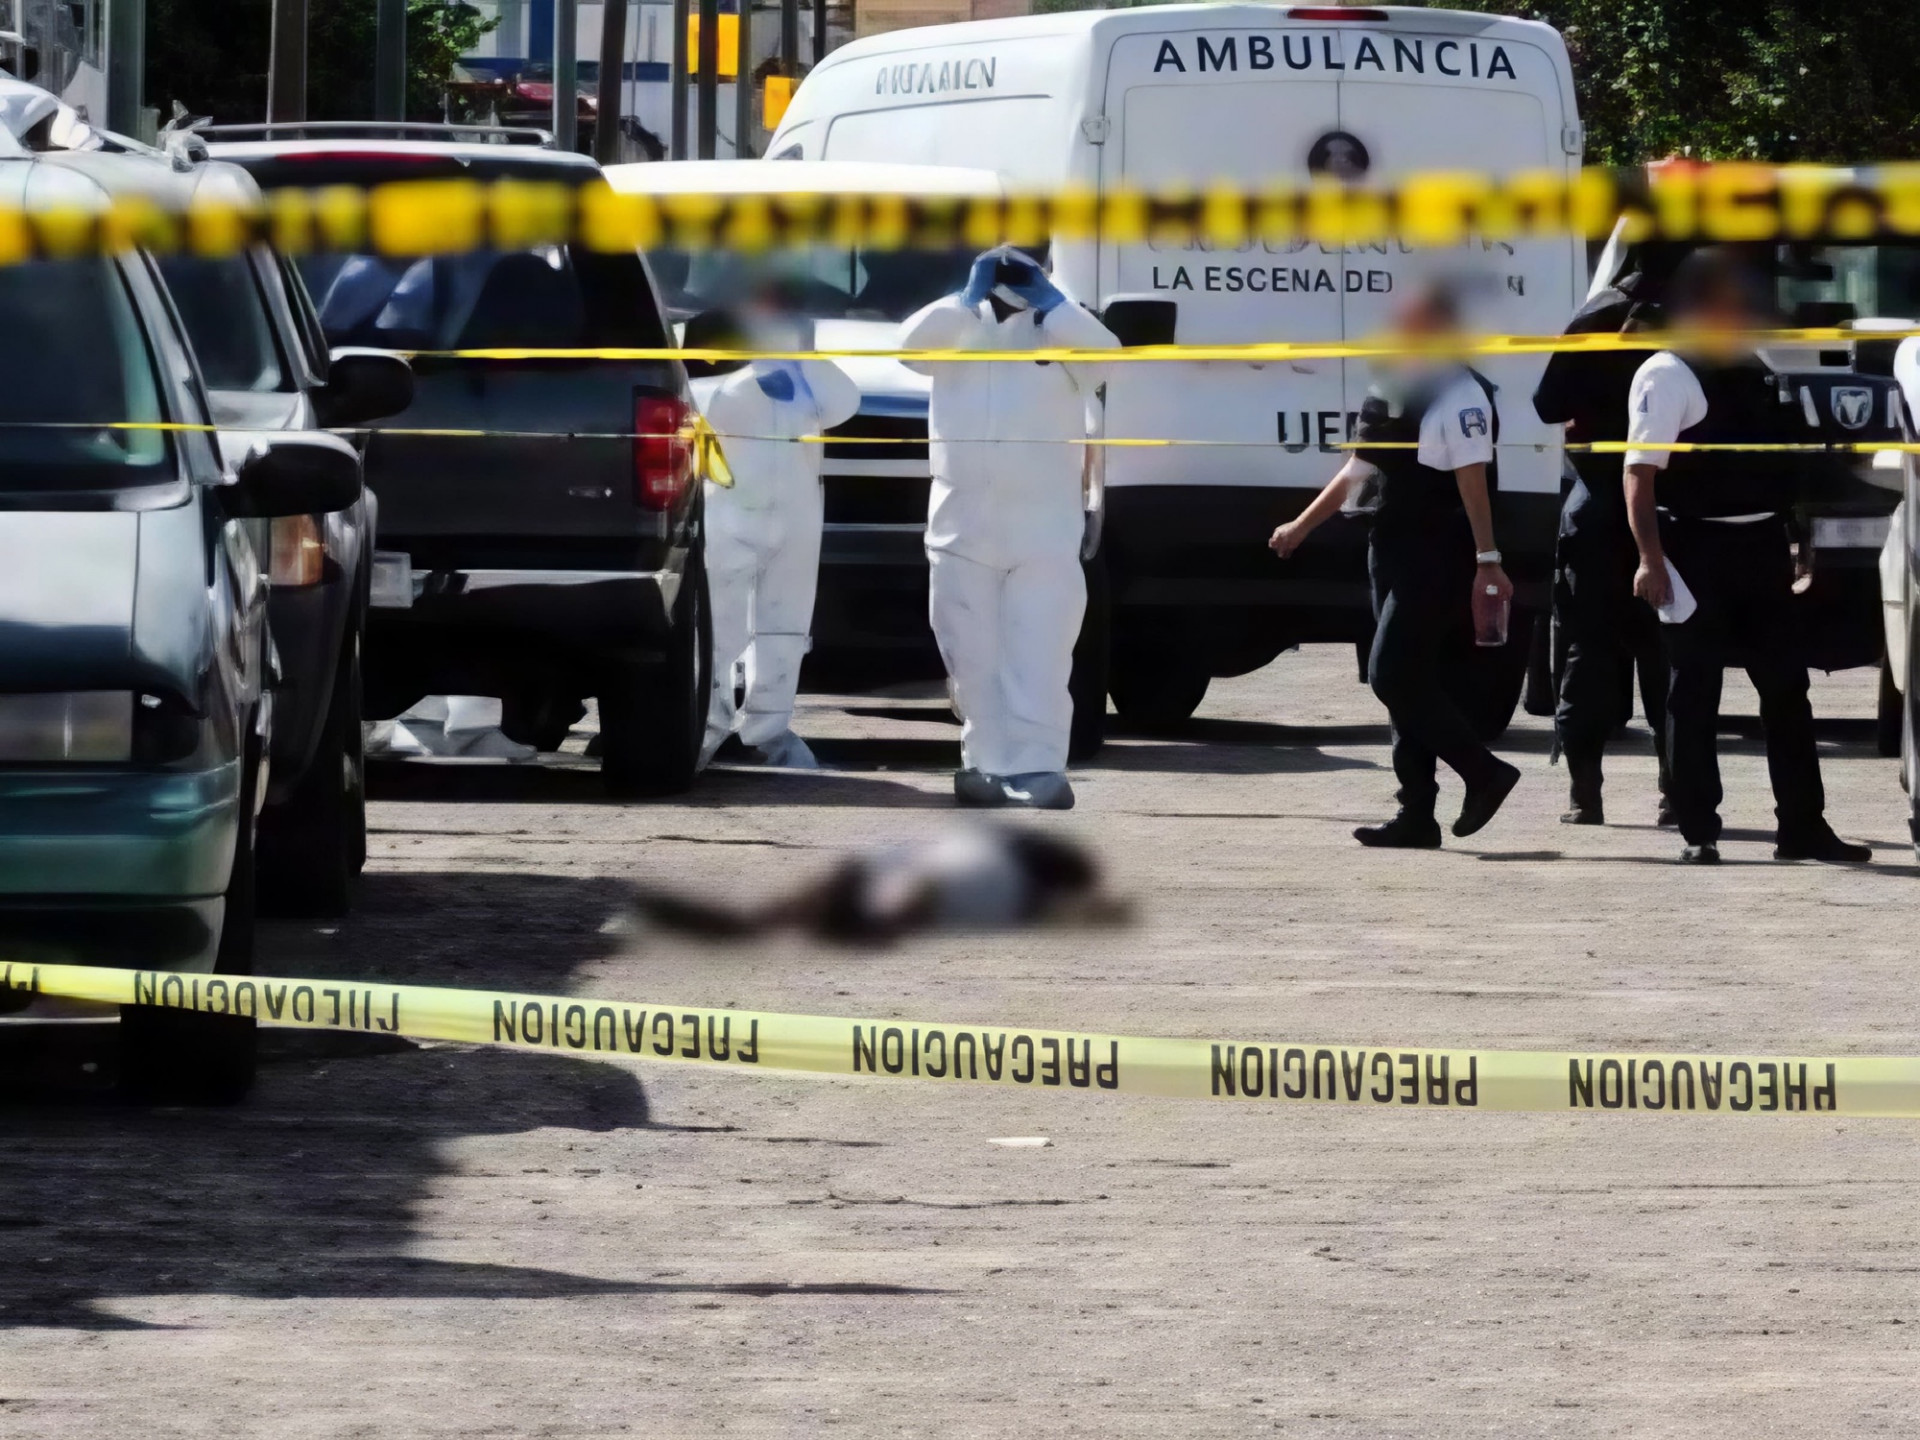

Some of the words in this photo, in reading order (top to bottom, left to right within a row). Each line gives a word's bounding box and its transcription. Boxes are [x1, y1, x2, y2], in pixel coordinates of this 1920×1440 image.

[1153, 35, 1516, 80] AMBULANCIA
[1153, 266, 1194, 290] LA
[1205, 267, 1336, 292] ESCENA
[852, 1025, 1119, 1089] PRECAUCION
[1211, 1044, 1478, 1106] PRECAUCION
